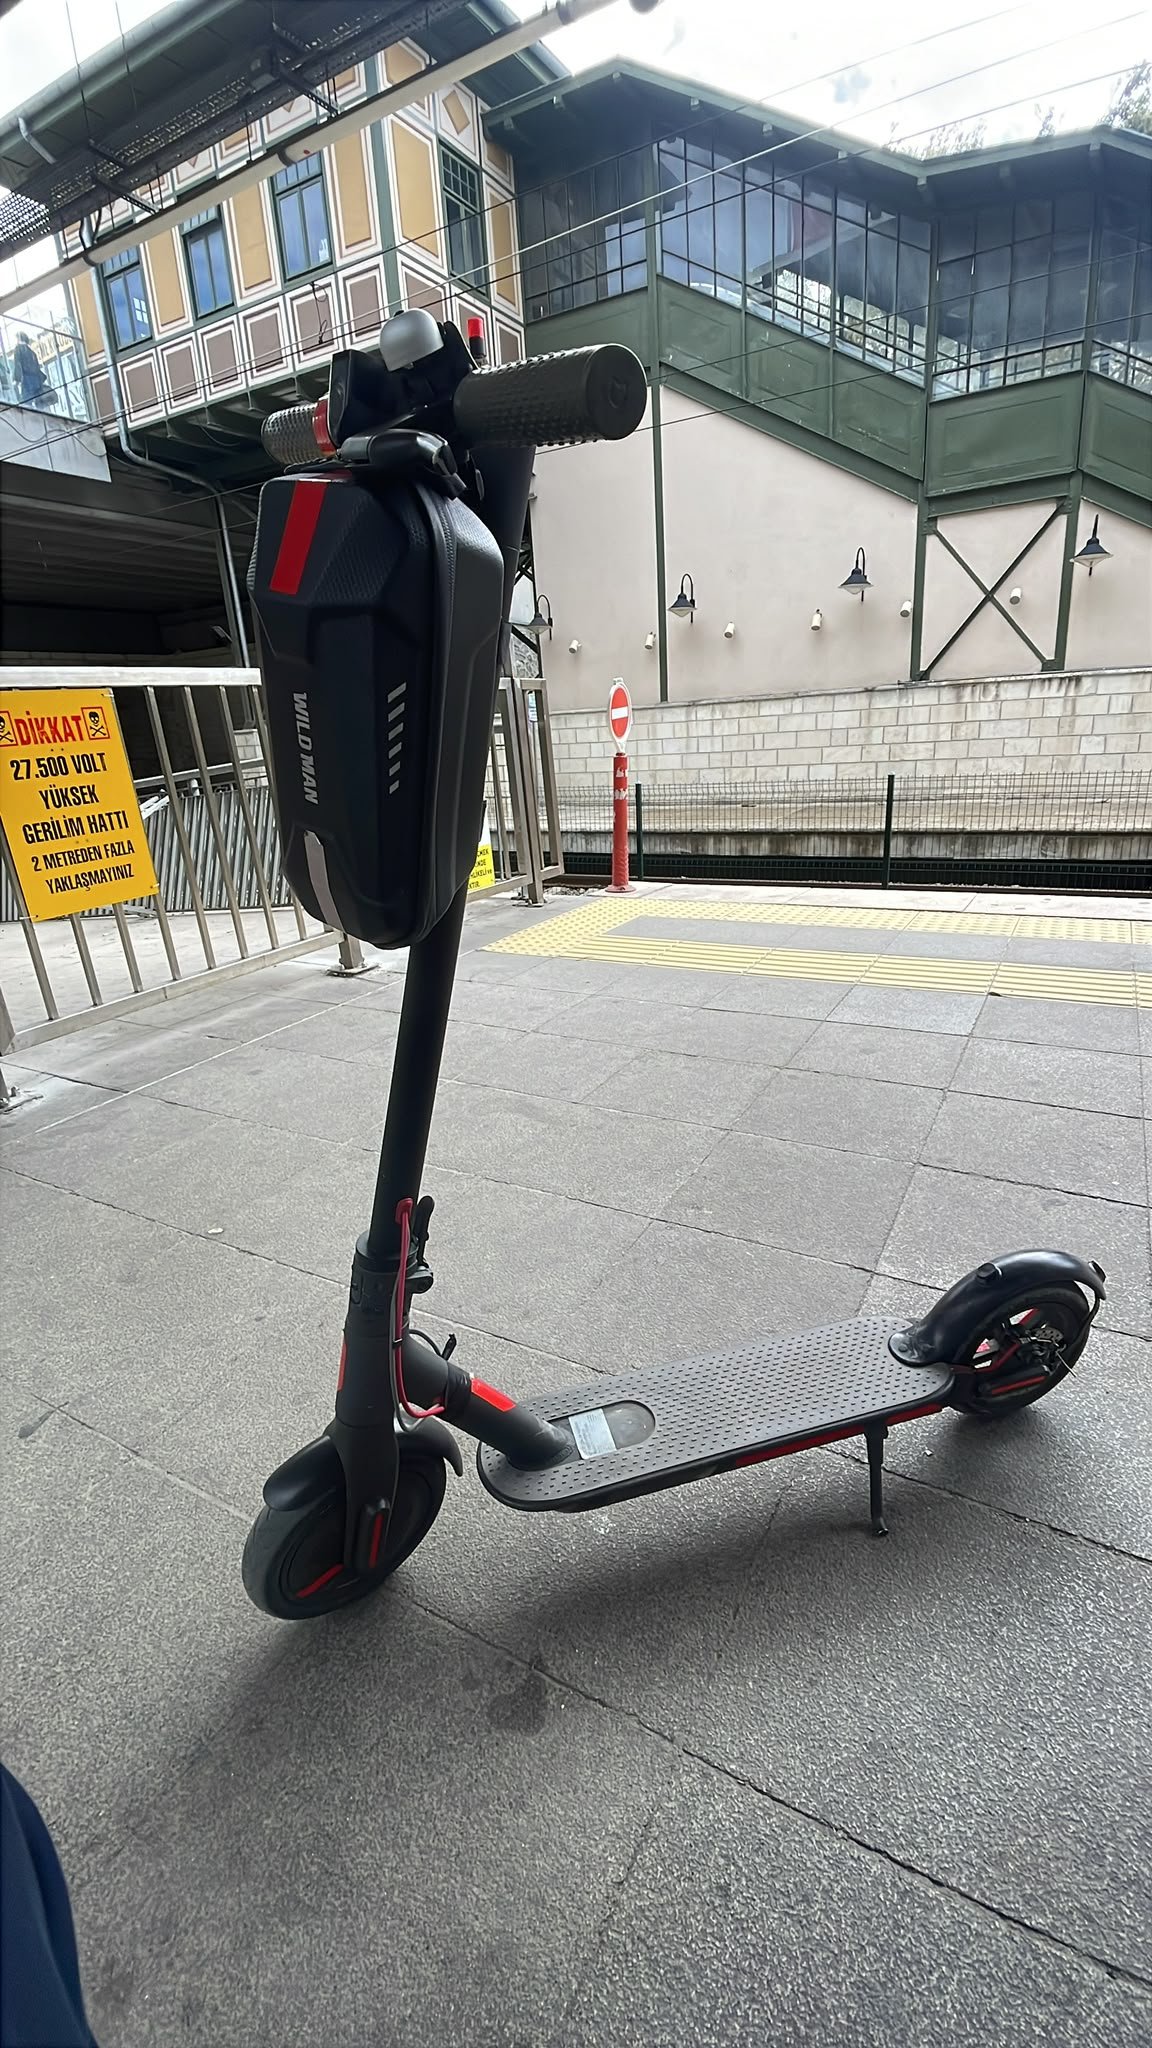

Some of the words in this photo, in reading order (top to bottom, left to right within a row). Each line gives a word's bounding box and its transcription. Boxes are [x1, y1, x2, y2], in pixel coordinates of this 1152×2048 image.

[14, 710, 84, 746] DİKKAT
[293, 692, 313, 751] WILD
[9, 755, 69, 781] 27.500
[70, 752, 108, 775] VOLT
[300, 752, 319, 805] MAN
[39, 783, 100, 810] YÜKSEK
[22, 814, 86, 845] GERİLİM
[88, 810, 129, 836] HATTI
[31, 856, 43, 872] 2
[43, 844, 103, 871] METREDEN
[104, 839, 136, 860] FAZLA
[45, 863, 135, 895] YAKLAŞMAYINIZ
